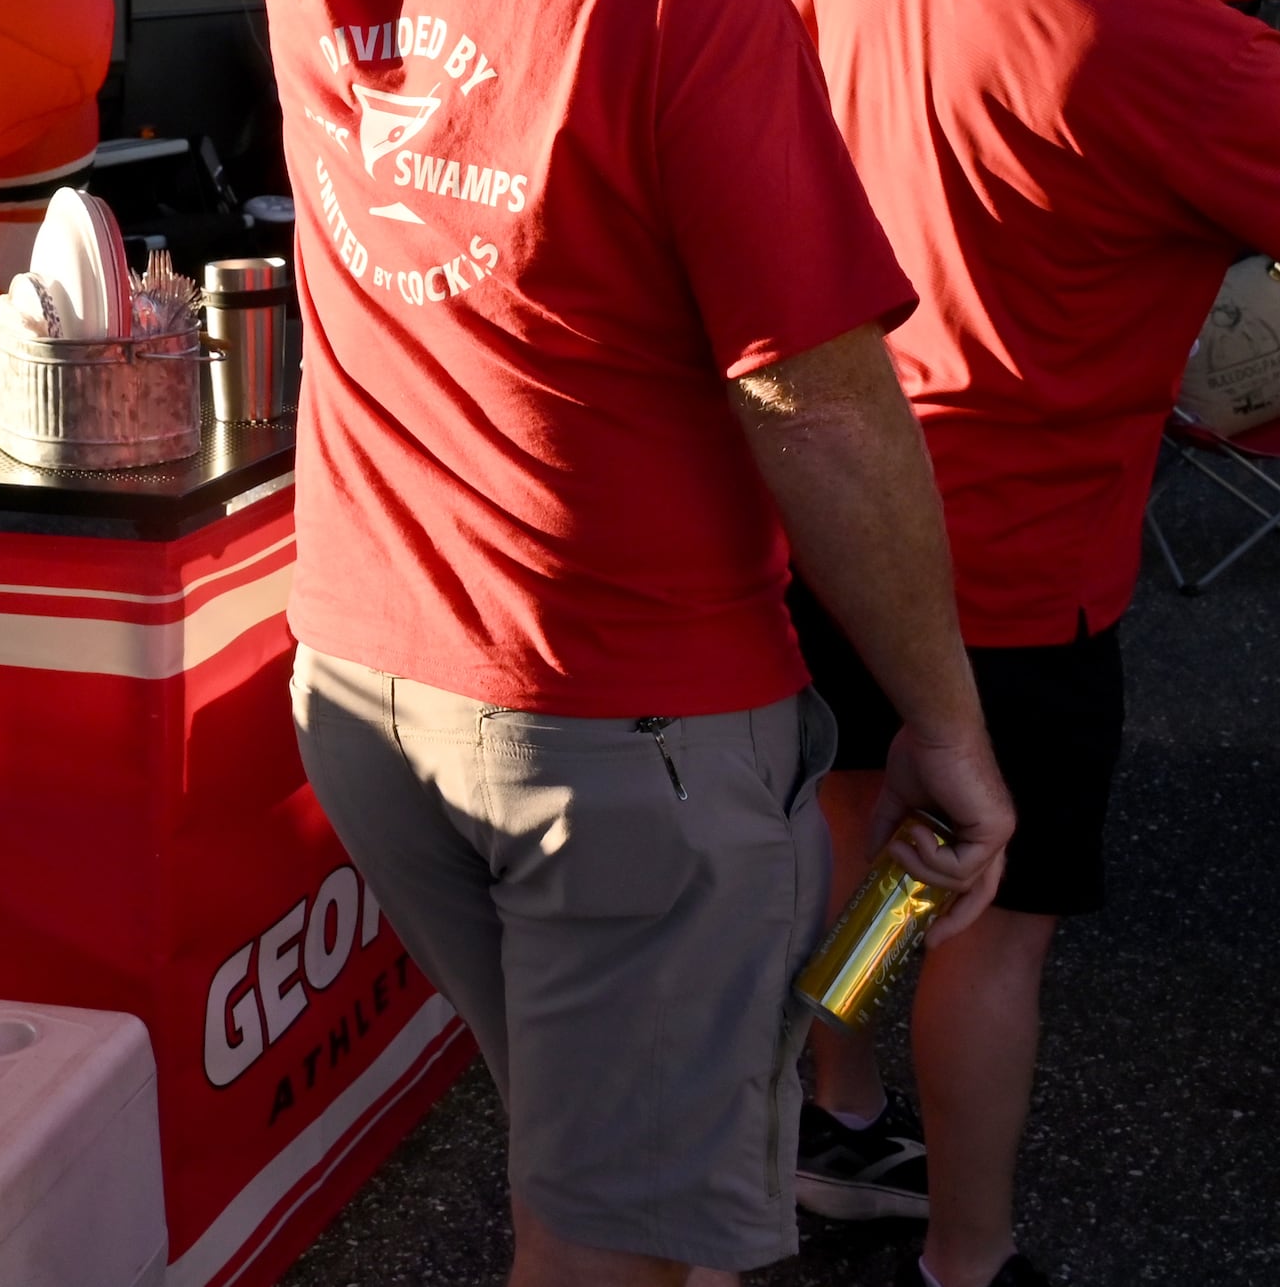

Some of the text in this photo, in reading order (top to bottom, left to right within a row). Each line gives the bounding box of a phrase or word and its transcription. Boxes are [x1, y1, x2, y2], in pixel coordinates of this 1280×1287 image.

[319, 15, 498, 97] DIVIDED BY
[394, 149, 528, 214] SWAMPS
[316, 155, 369, 279] UNITED
[373, 266, 393, 291] BY
